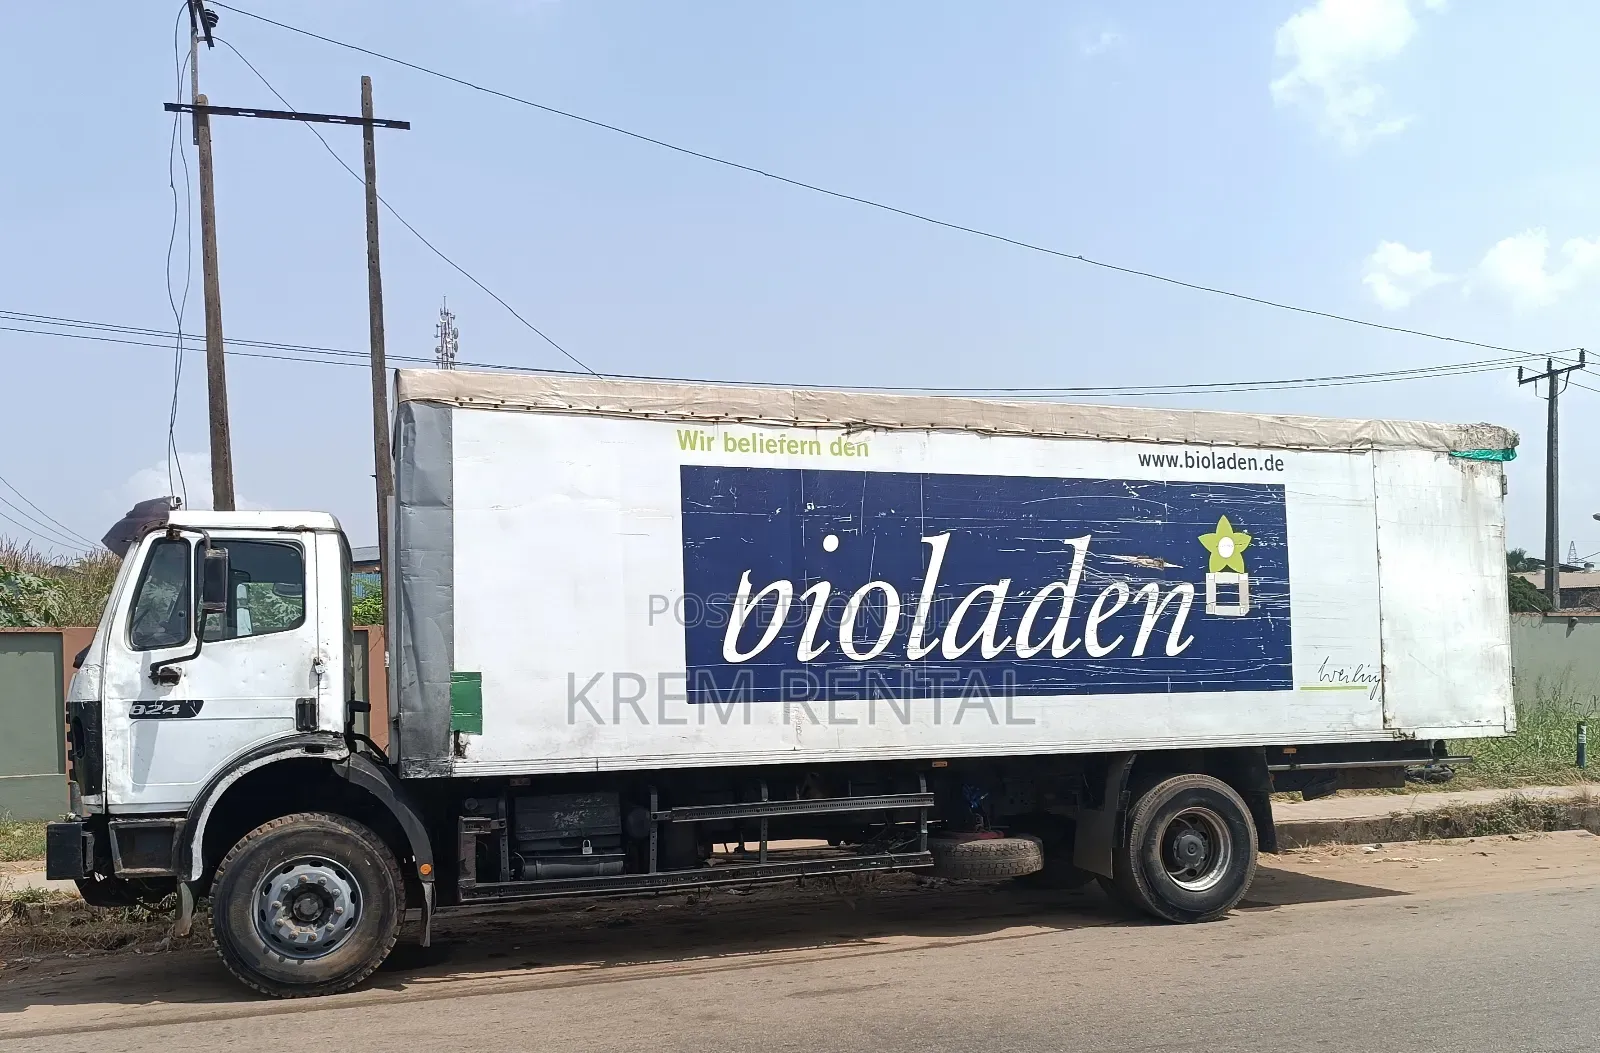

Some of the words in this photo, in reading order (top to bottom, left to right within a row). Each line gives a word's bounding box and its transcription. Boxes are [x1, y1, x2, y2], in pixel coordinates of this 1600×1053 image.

[677, 430, 716, 451] Wir
[723, 432, 821, 455] beliefern
[829, 436, 869, 457] den
[1138, 451, 1284, 471] www.bioladen.de
[722, 532, 1195, 663] bioladen
